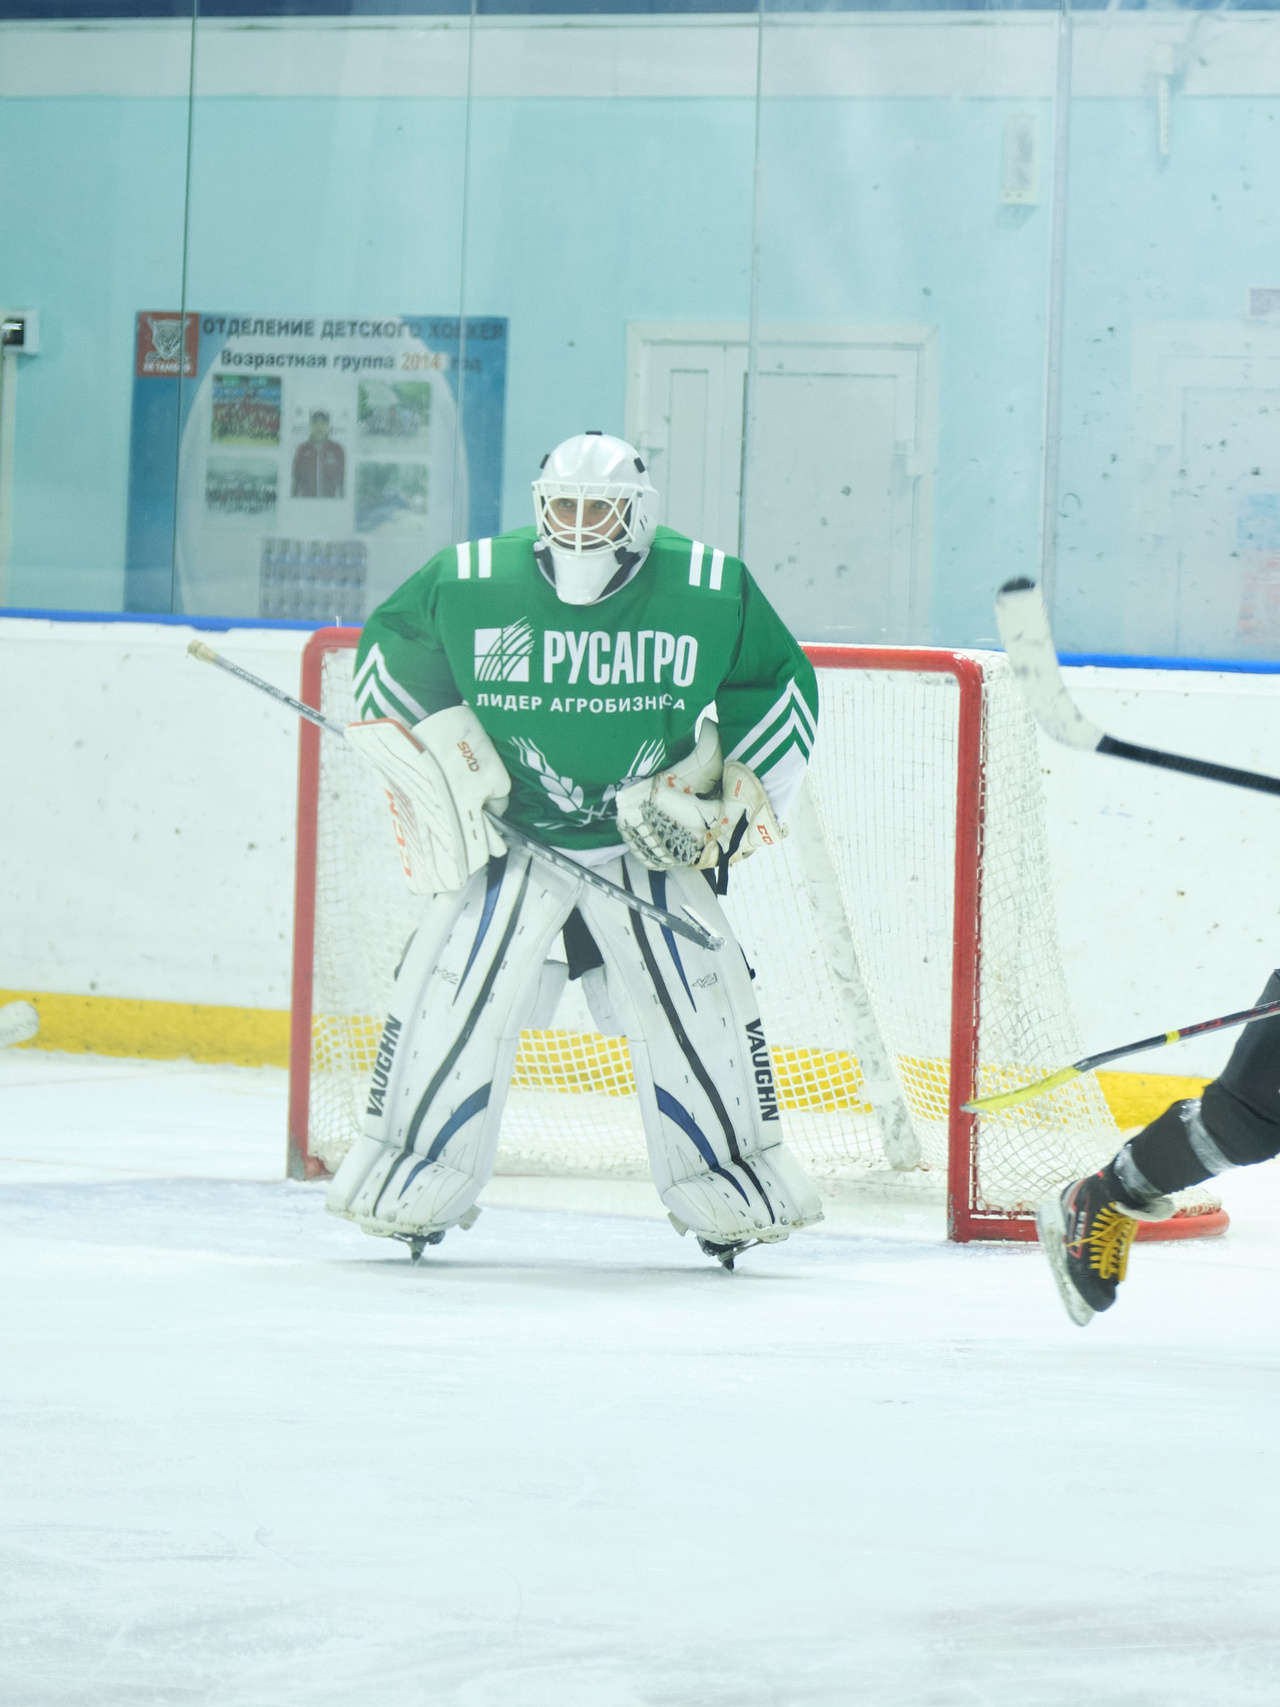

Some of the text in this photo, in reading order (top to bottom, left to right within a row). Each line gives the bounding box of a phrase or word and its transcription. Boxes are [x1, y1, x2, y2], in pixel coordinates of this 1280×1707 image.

[202, 317, 315, 337] ОТДЕЛЕНИЕ
[320, 319, 422, 340] ДЕТСКОГО
[220, 349, 327, 370] Возрастная
[333, 355, 394, 373] группа
[402, 353, 441, 372] 2014
[543, 630, 698, 687] РУСАГРО
[476, 693, 542, 712] ЛИДЕР
[366, 1013, 402, 1118] VAUGHN
[745, 1017, 780, 1122] VAUGHN
